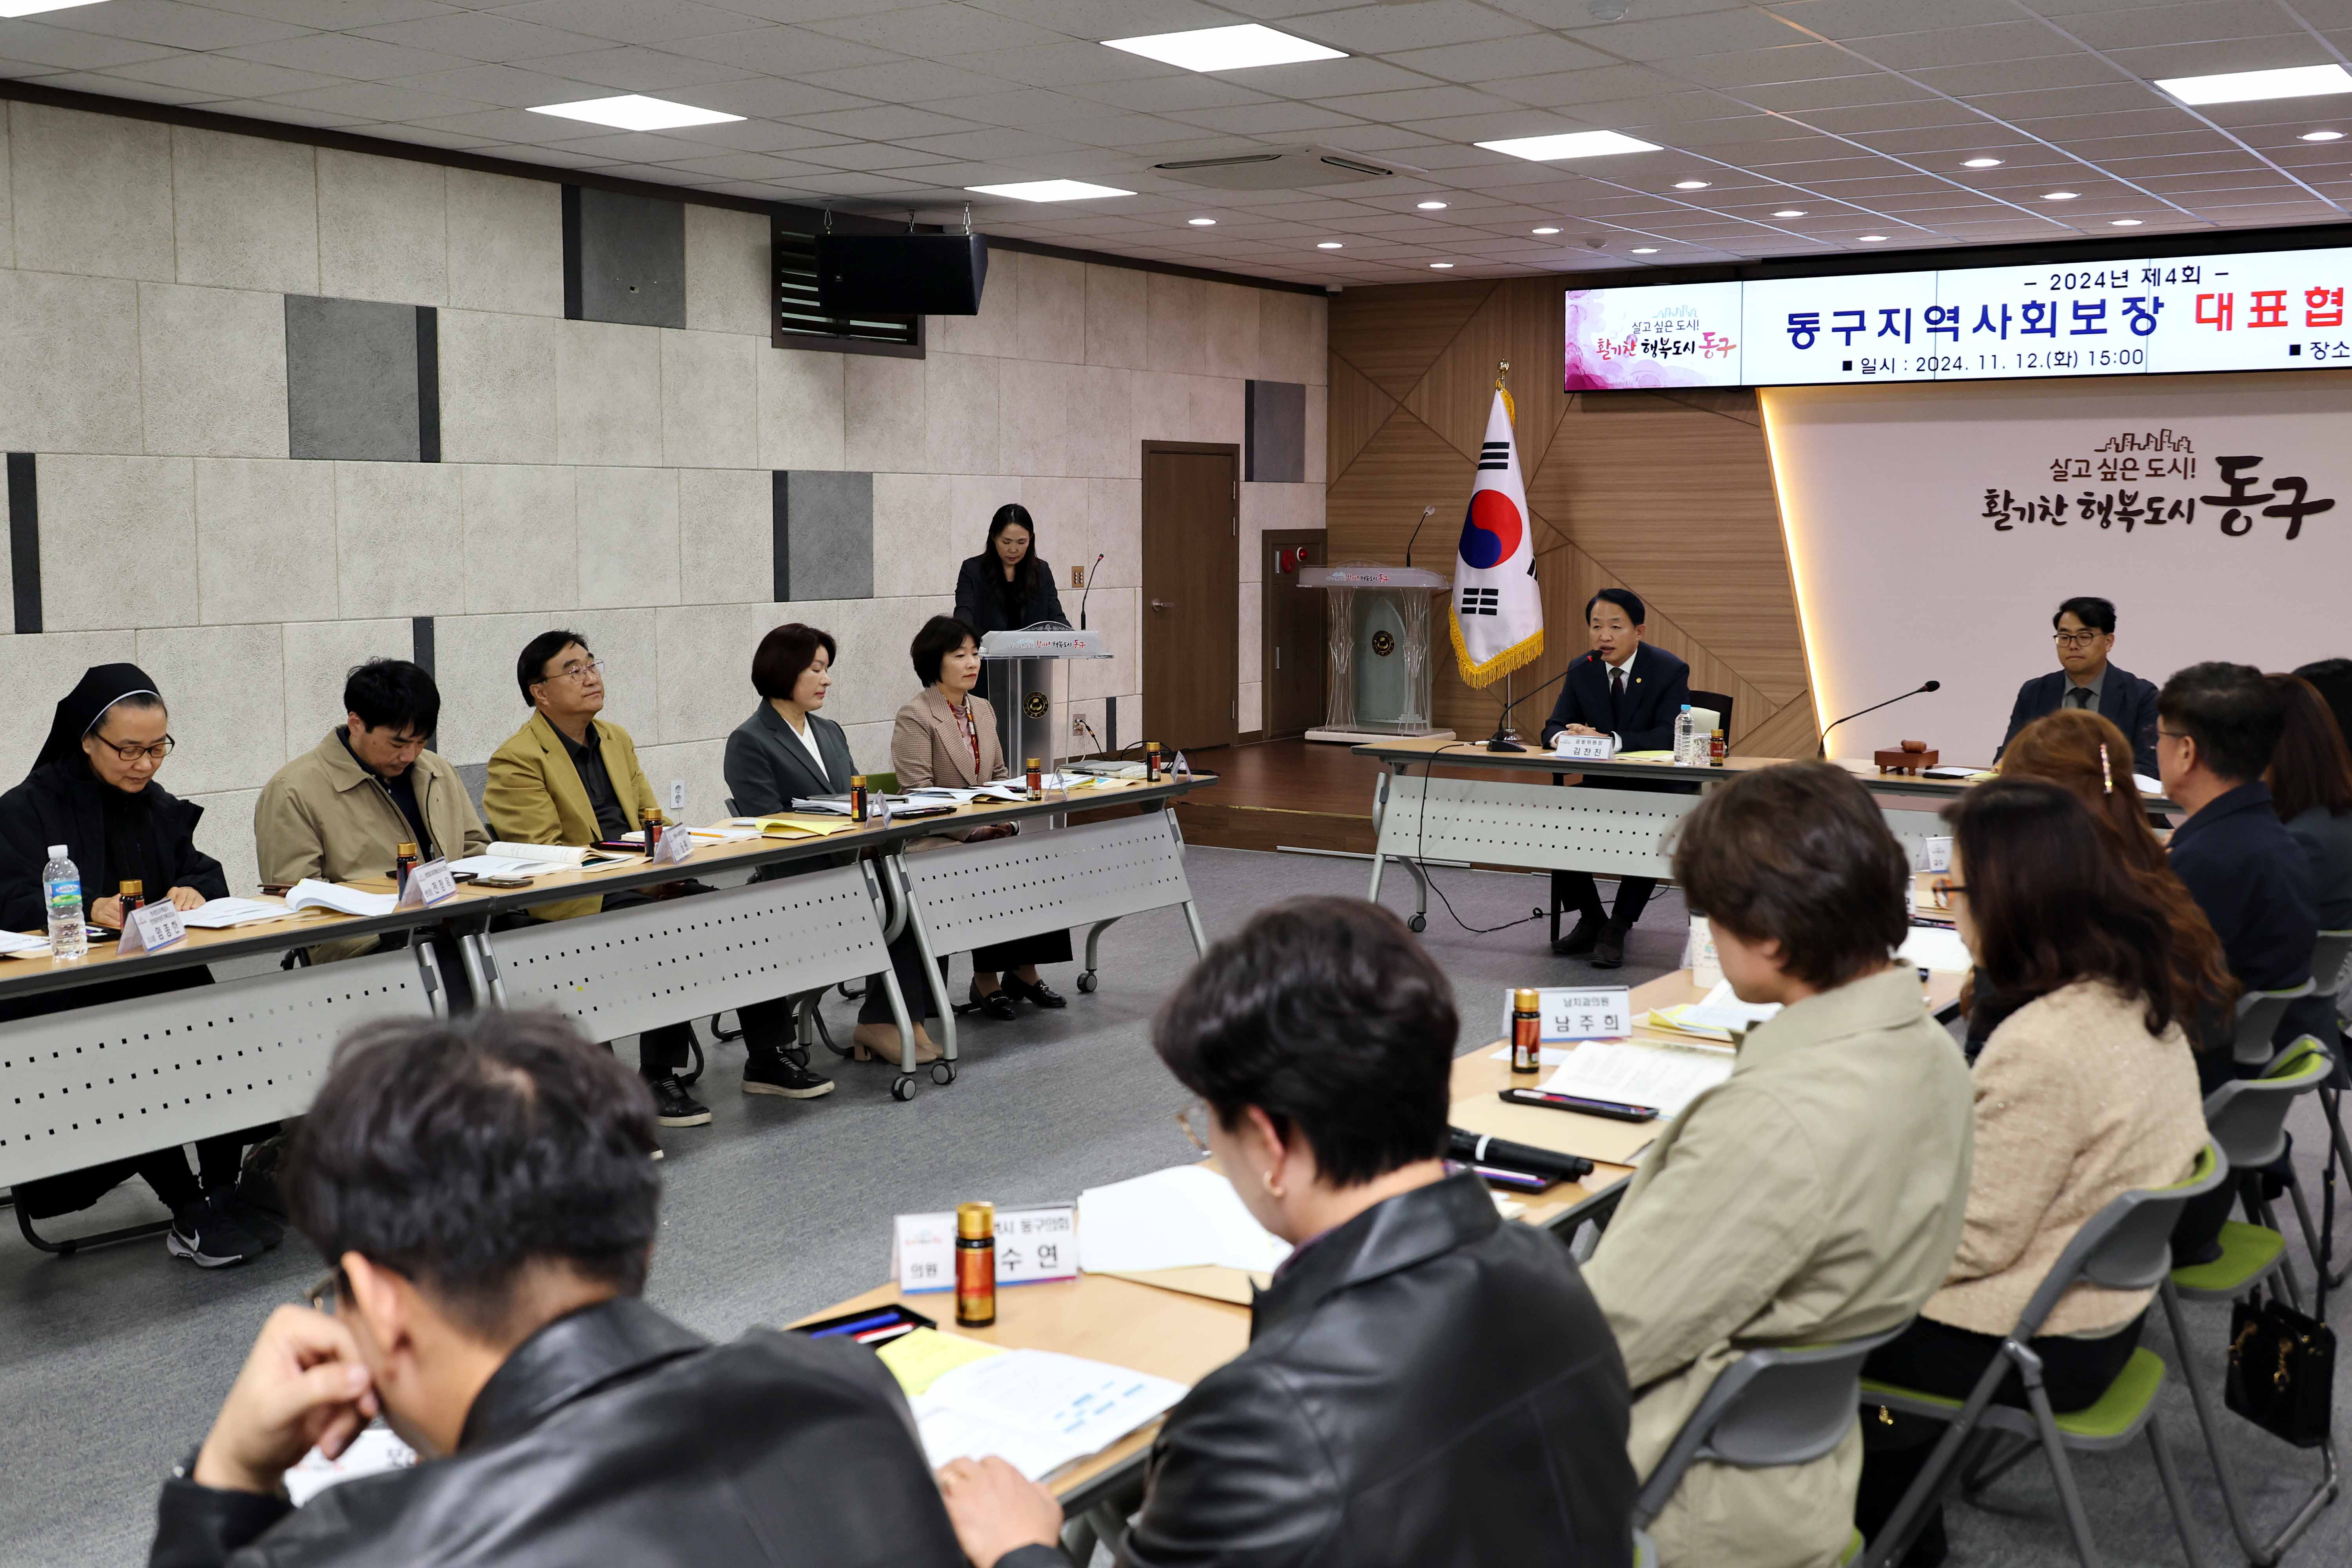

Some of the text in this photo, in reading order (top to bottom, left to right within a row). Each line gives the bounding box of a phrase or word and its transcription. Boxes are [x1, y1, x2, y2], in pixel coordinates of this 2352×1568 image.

[2050, 270, 2128, 291] 2024년
[2141, 265, 2200, 287] 제4회
[1632, 319, 1699, 334] 살고 싶은 도시!
[1787, 286, 2344, 350] 동구지역사회보장 대표협
[1596, 332, 1737, 360] 활기찬 행복도시 동구
[2310, 341, 2350, 360] 장소
[1861, 358, 1895, 374] 일시
[1916, 356, 1969, 372] 2024.
[1979, 354, 2005, 370] 11.
[2089, 349, 2143, 366] 15:00
[2050, 456, 2196, 482] 살고 싶은 도시!
[1982, 455, 2336, 540] 활기찬 행복도시 동구
[1073, 639, 1086, 649] 동구
